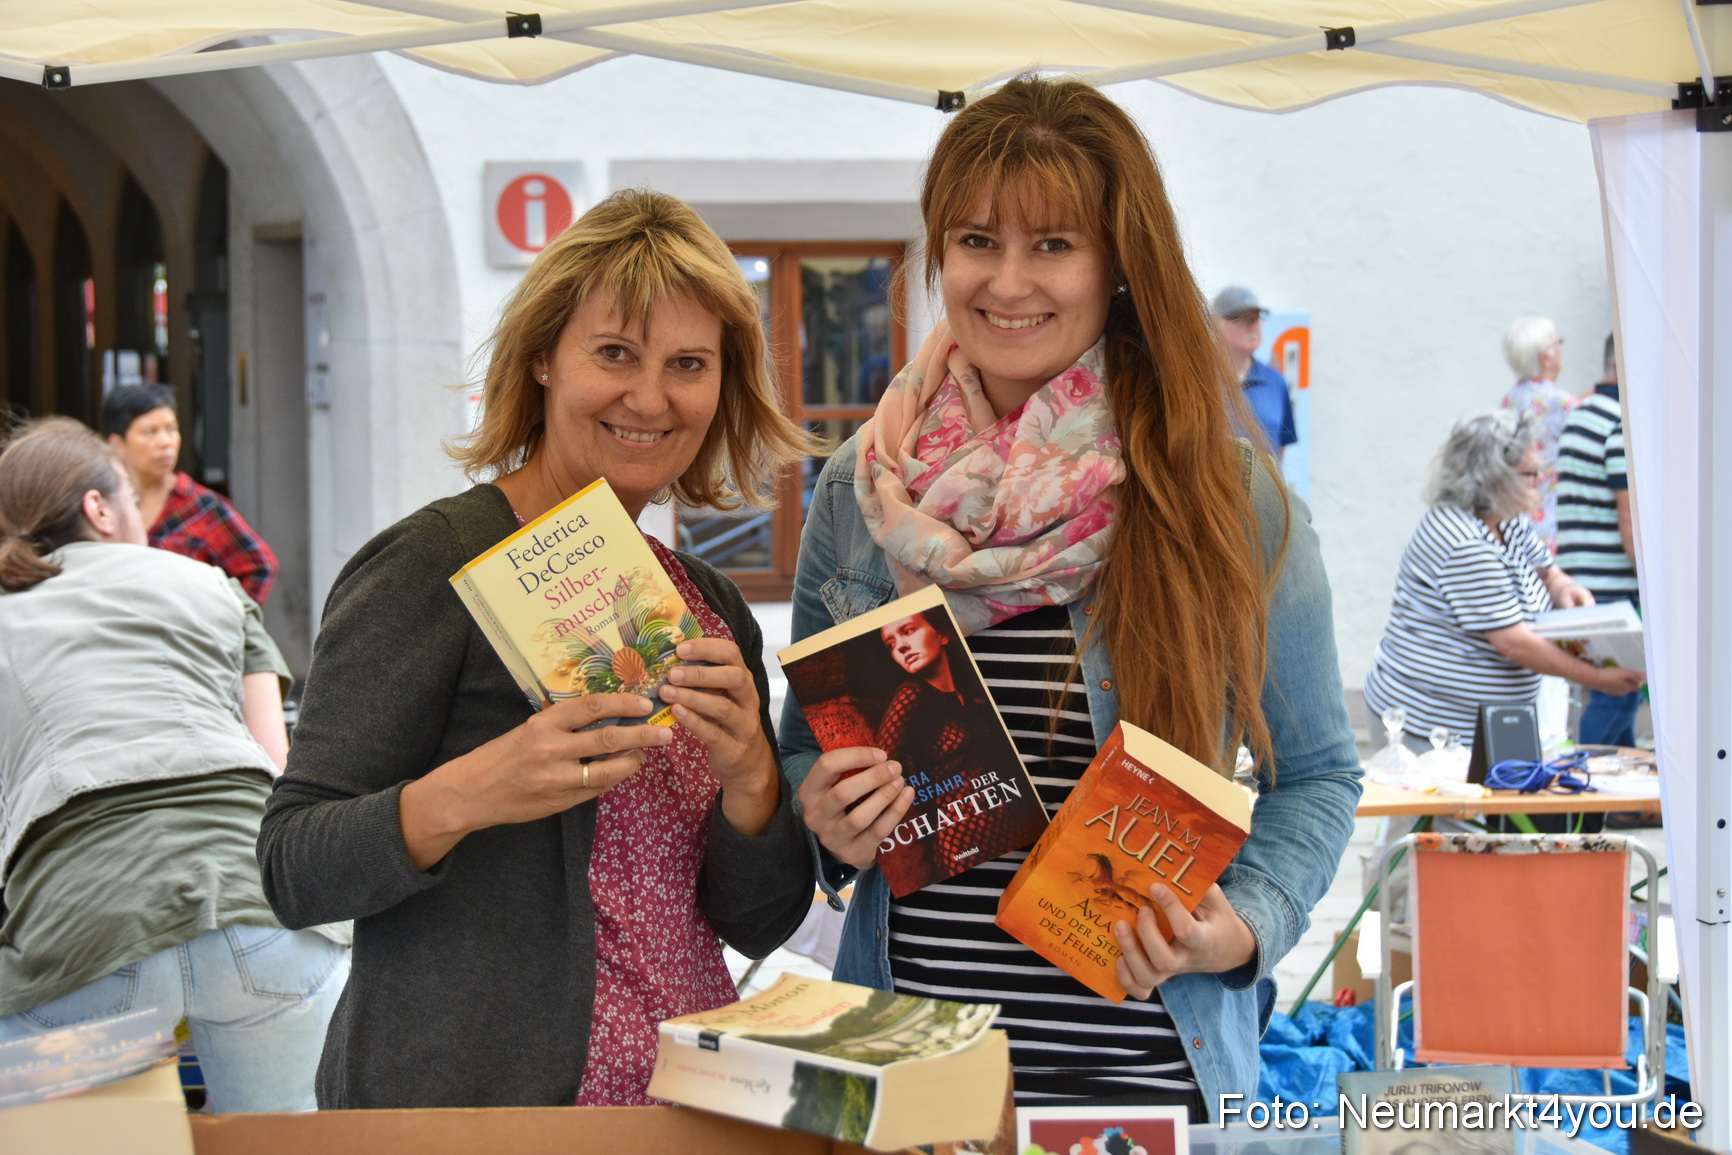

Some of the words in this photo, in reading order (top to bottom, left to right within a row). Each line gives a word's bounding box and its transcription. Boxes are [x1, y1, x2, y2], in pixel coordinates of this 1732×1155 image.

[505, 514, 590, 571] Federica
[516, 535, 605, 595] DeCesco
[544, 565, 608, 610] Silber-
[553, 574, 632, 637] muschel
[585, 612, 620, 637] Roman
[650, 707, 672, 726] GOLDMA
[903, 771, 930, 788] TRA
[970, 771, 999, 789] DER
[1121, 759, 1150, 782] HEYNE
[912, 775, 965, 806] ESFAHR
[878, 777, 1022, 854] SCHATTEN
[1124, 793, 1179, 833] JEAN
[1177, 827, 1202, 852] M
[953, 846, 979, 861] Weltbild
[1084, 804, 1195, 896] AUEL
[1037, 898, 1067, 919] UND
[1067, 917, 1092, 938] DER
[1039, 917, 1064, 936] DES
[1062, 932, 1108, 967] FEUERS
[1047, 942, 1081, 967] ROMAN
[1384, 1084, 1417, 1097] JURIJ
[1419, 1081, 1482, 1095] TRIFONOW
